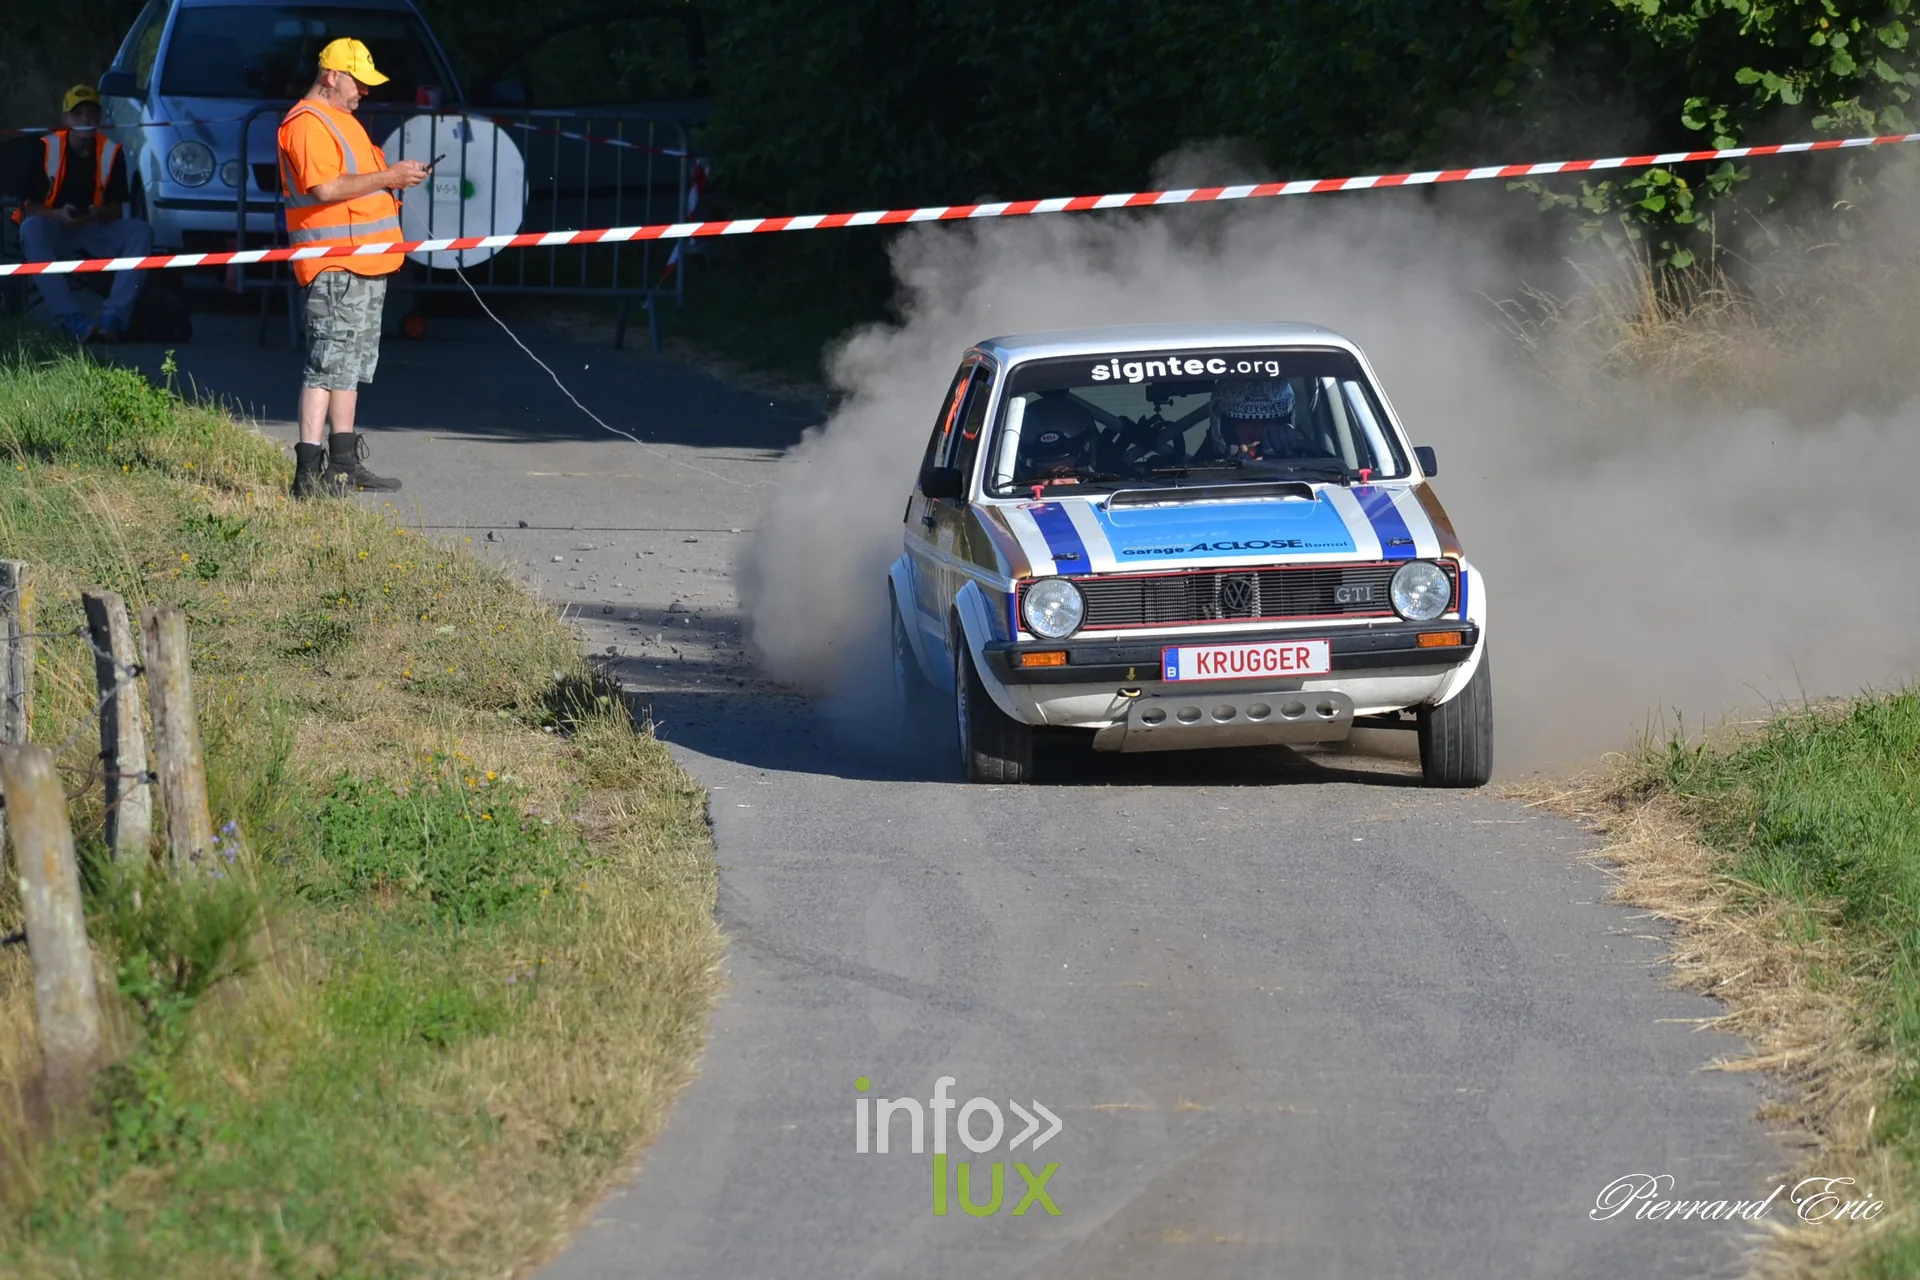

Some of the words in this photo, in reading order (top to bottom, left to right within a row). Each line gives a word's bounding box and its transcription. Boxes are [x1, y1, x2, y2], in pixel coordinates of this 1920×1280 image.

[1091, 356, 1280, 383] signtec.org
[1122, 547, 1185, 556] Garage
[1188, 539, 1304, 552] A.CLOSE
[1336, 586, 1372, 602] GTI
[1197, 646, 1310, 675] KRUGGER
[1167, 666, 1177, 678] B
